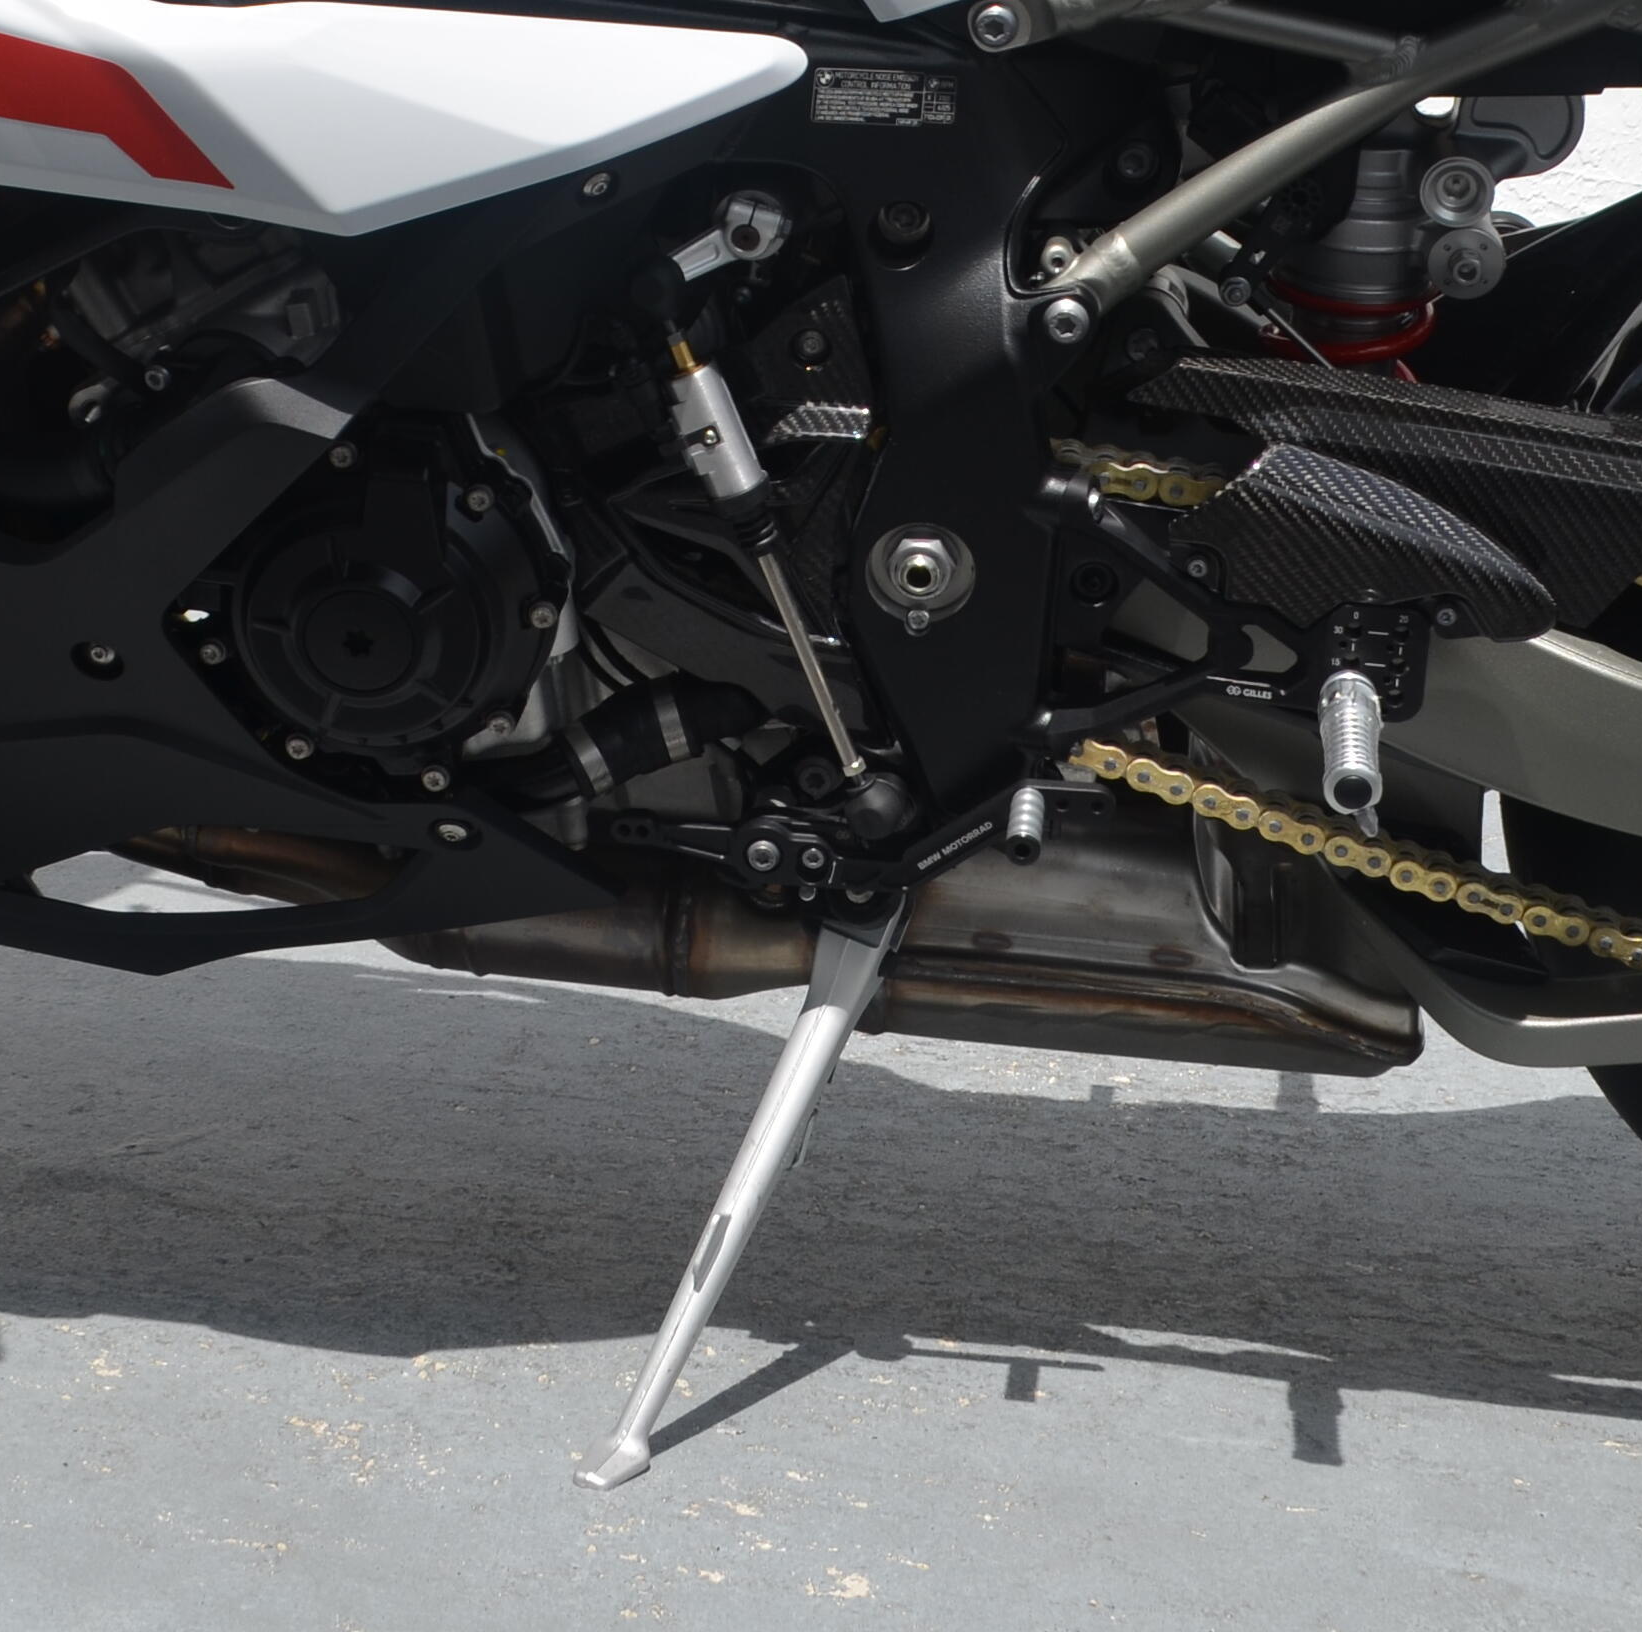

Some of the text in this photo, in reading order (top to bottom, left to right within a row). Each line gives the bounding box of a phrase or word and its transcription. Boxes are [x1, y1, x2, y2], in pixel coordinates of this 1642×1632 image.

[1333, 625, 1344, 635] 30
[1330, 657, 1341, 667] 15
[1242, 688, 1273, 700] GILLES
[917, 821, 993, 870] BMW MOTORRAD
